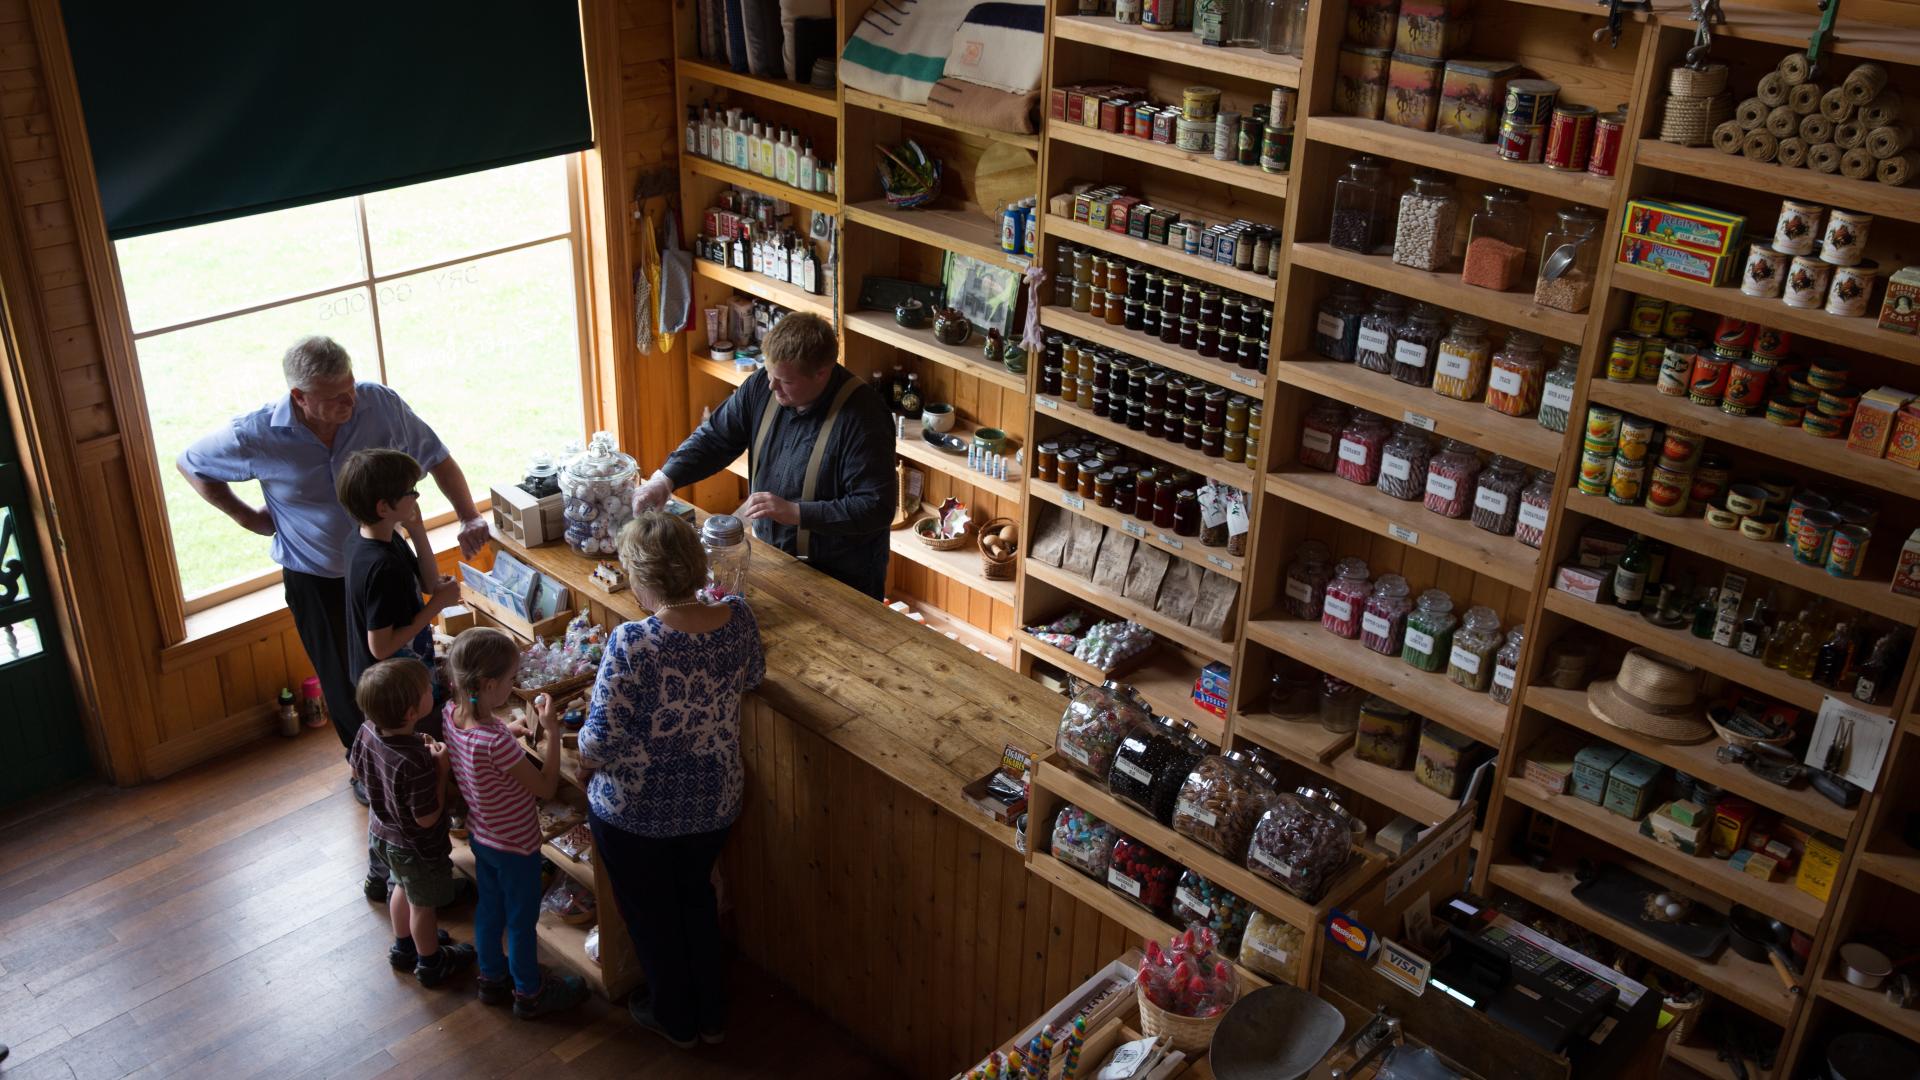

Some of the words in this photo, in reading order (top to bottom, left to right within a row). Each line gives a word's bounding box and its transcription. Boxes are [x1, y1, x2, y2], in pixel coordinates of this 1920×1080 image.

[1661, 214, 1700, 230] REGINA
[1652, 242, 1690, 260] REGINA
[1721, 400, 1747, 414] SALMON
[1005, 748, 1025, 761] CIGARS
[1330, 921, 1366, 948] MasterCard
[1389, 952, 1417, 976] VISA
[1080, 988, 1113, 1017] TAFFY
